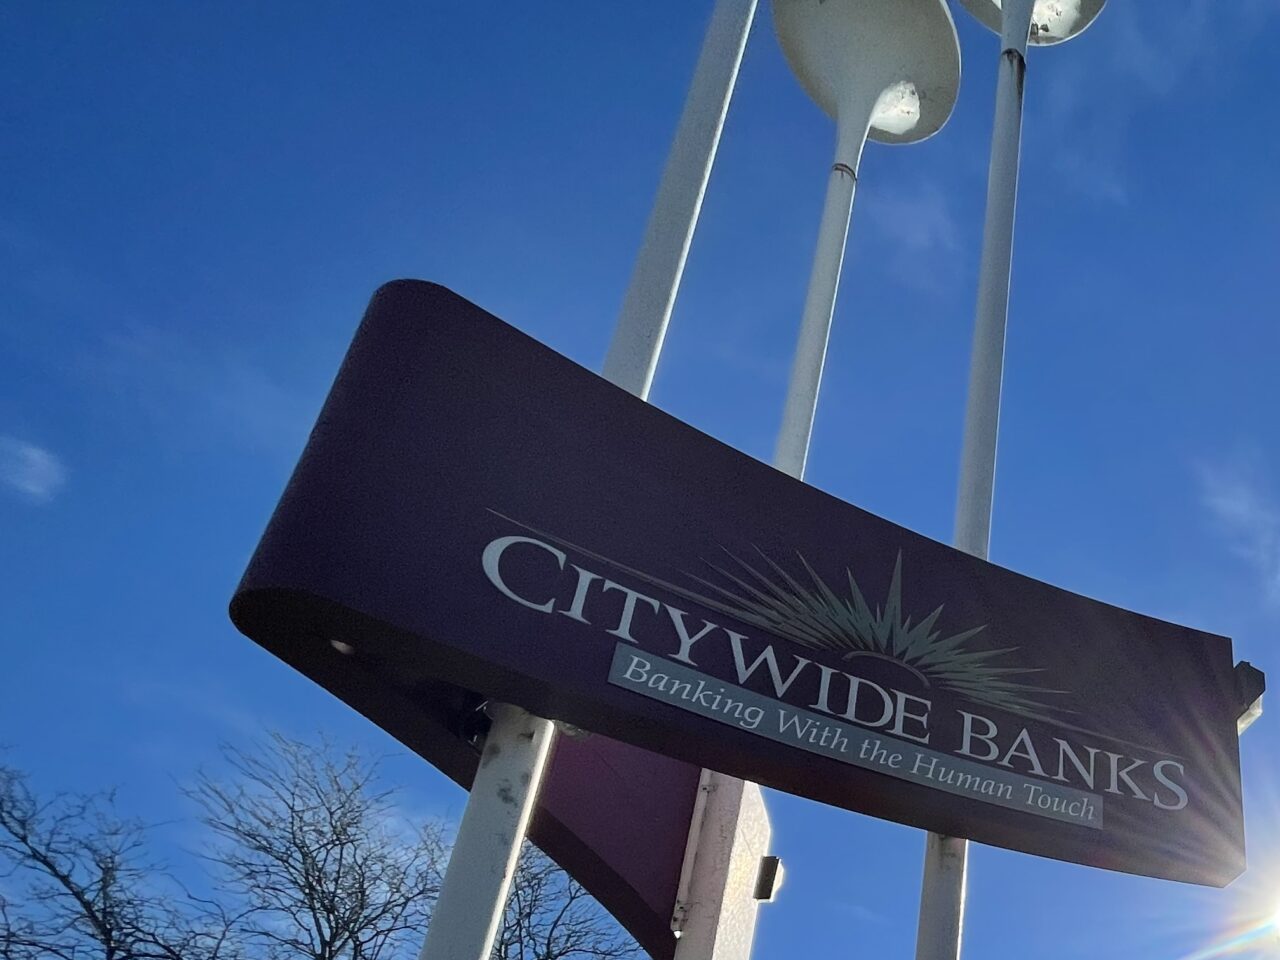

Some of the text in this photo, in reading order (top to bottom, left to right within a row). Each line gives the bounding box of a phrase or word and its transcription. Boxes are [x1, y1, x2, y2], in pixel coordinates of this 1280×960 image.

[482, 535, 1189, 811] CITYWIDE BANKS
[622, 654, 1096, 820] Banking With the Human Touch
